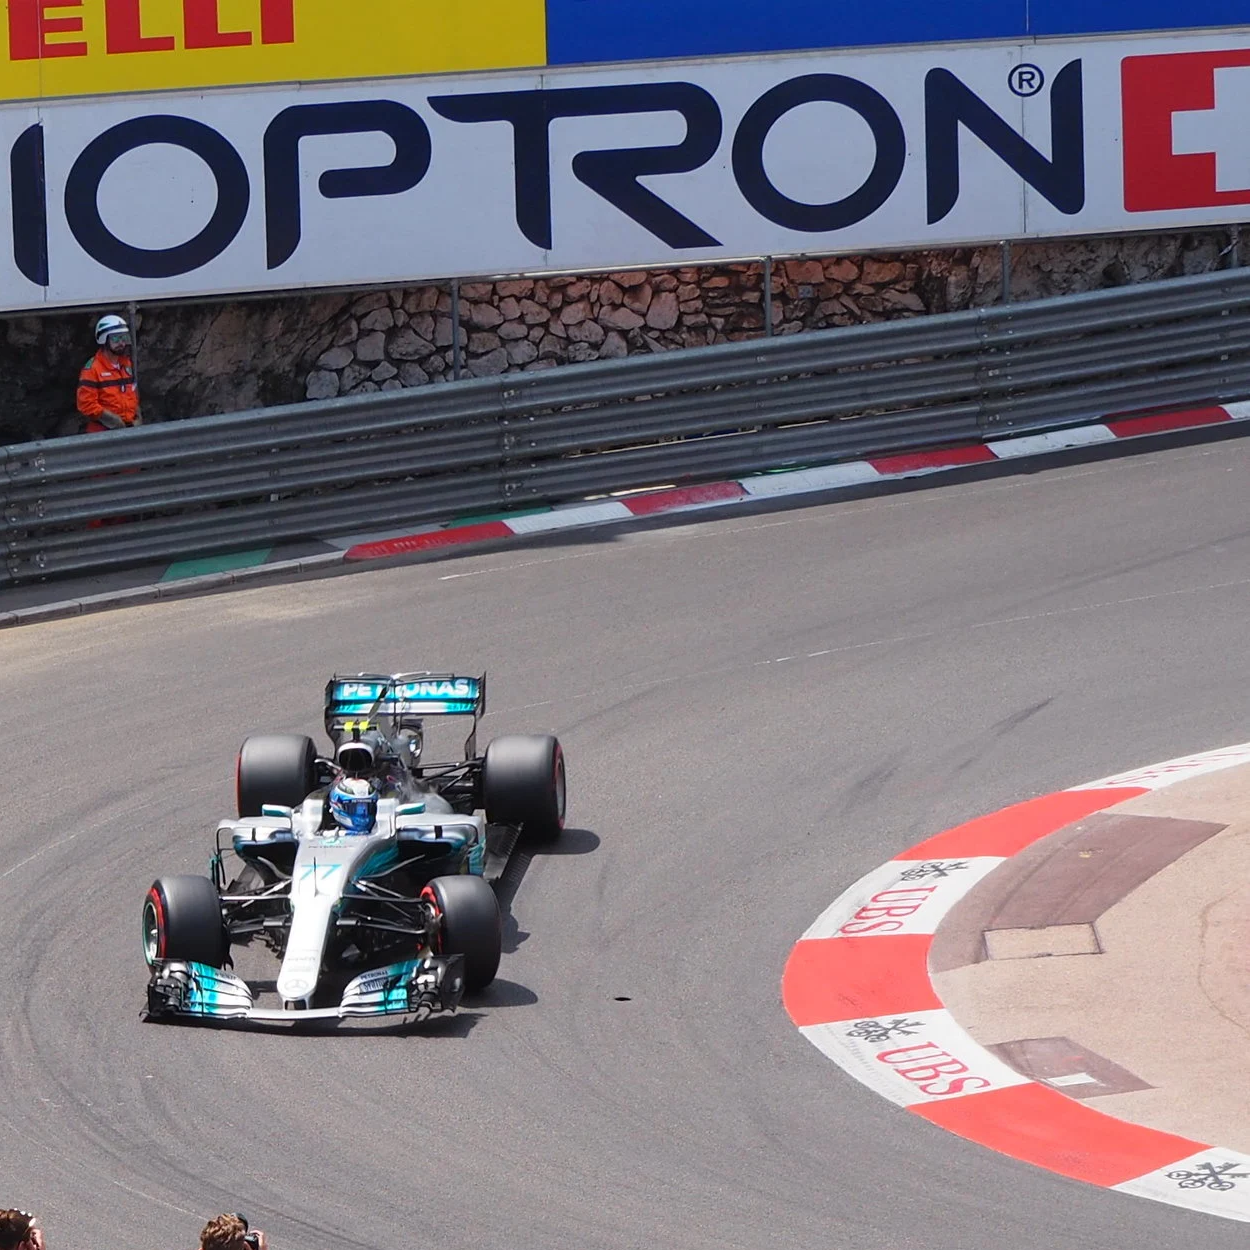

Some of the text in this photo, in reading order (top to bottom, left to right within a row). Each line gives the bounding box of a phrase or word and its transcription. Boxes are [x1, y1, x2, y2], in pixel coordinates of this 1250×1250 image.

[343, 679, 469, 698] PEONAS
[301, 863, 342, 881] 77
[840, 885, 937, 934] UBS
[876, 1041, 991, 1096] UBS
